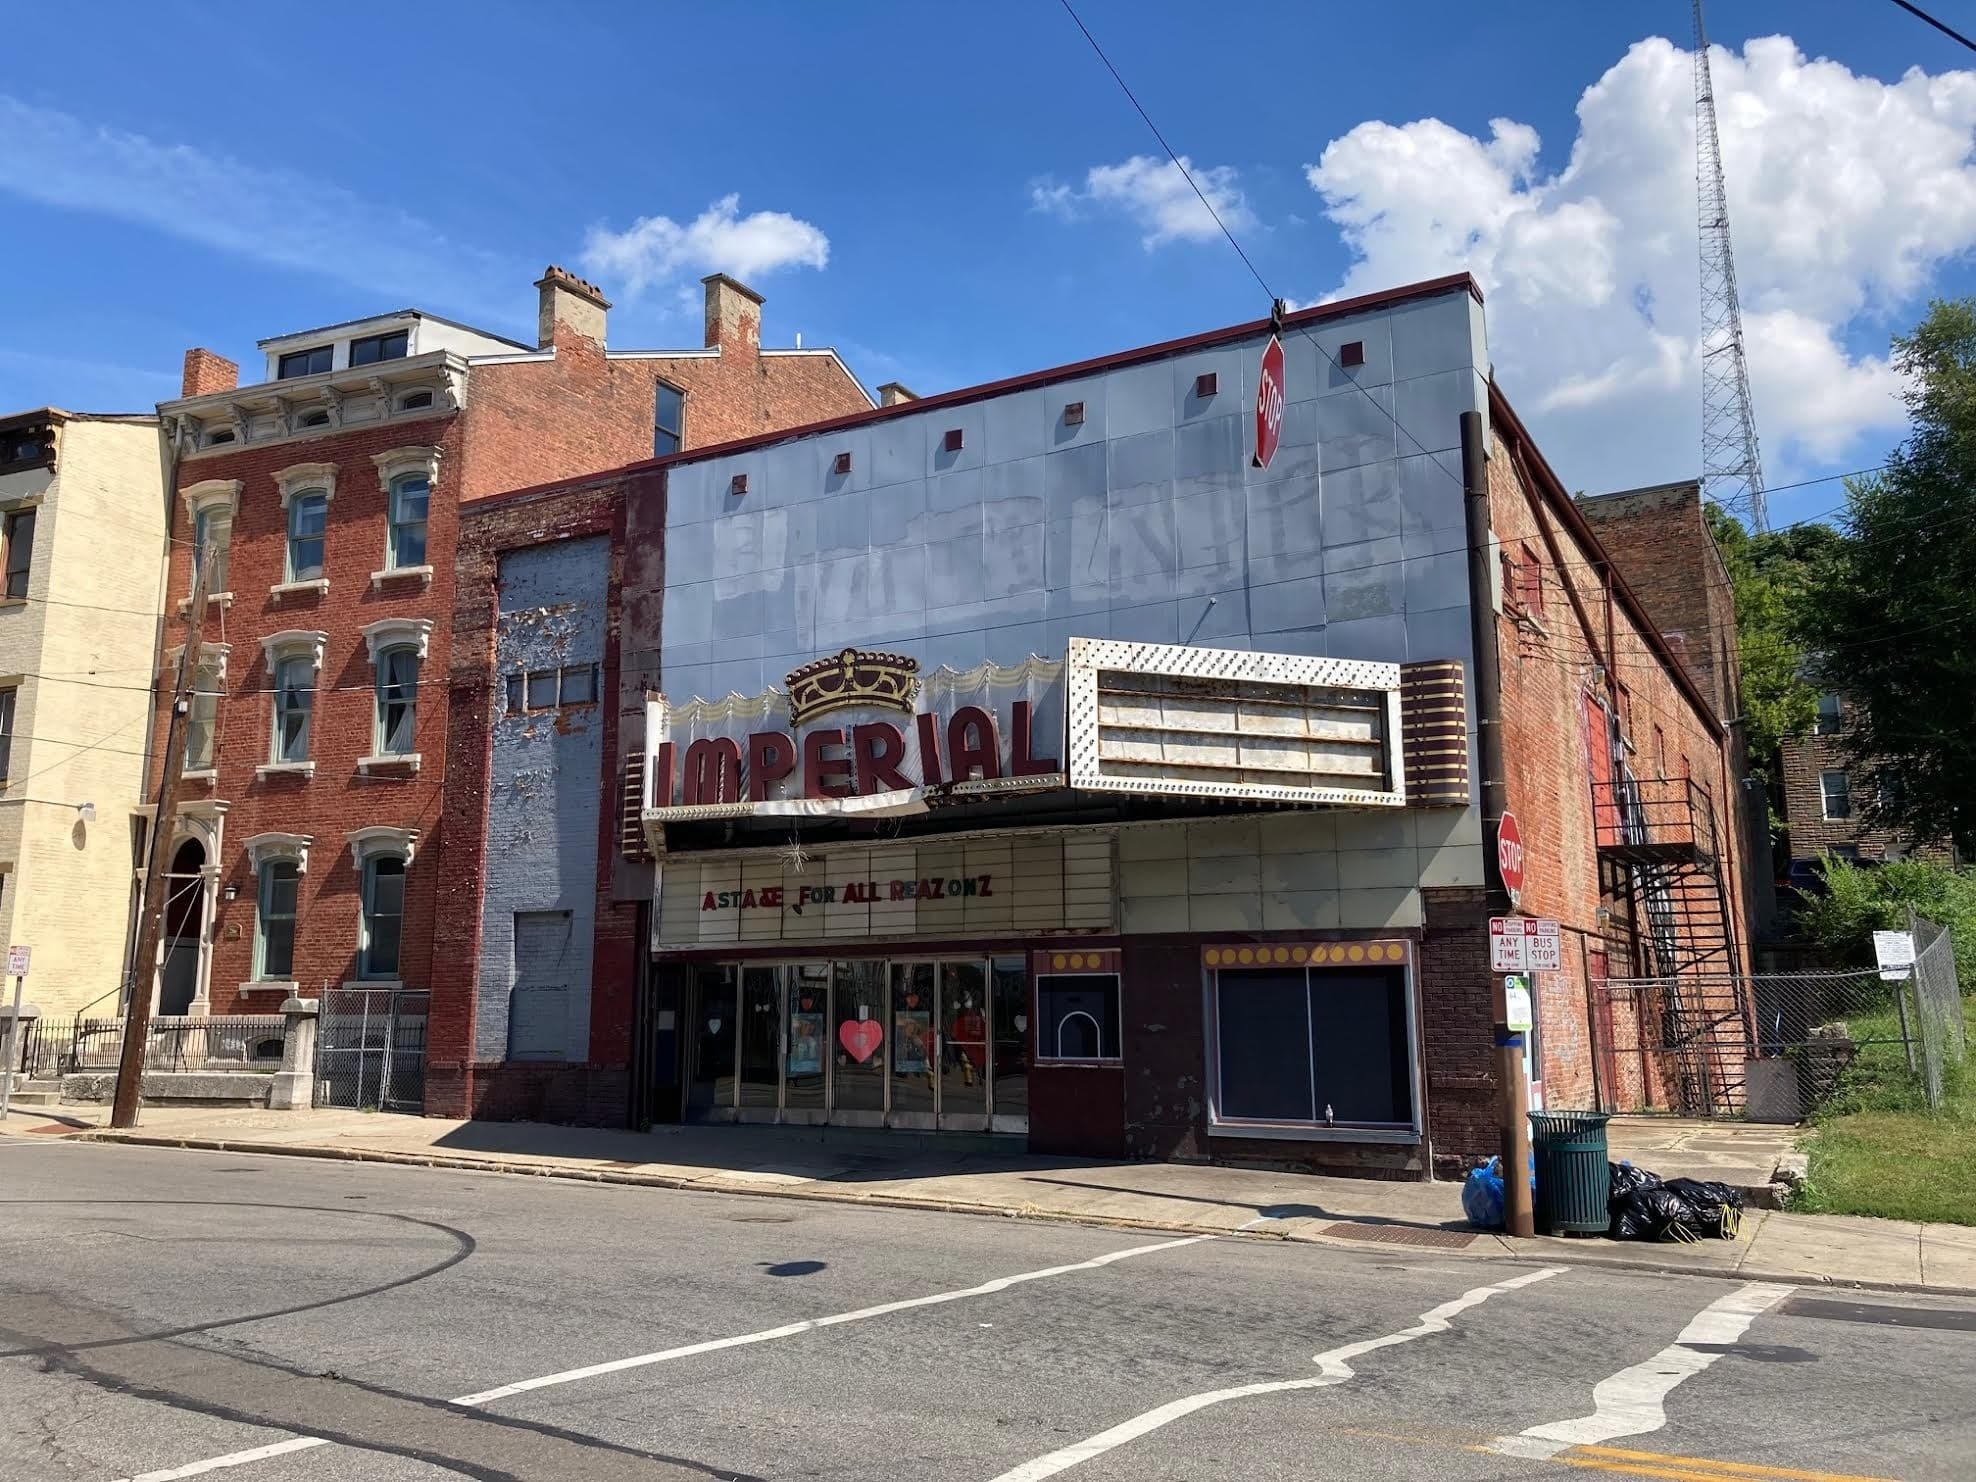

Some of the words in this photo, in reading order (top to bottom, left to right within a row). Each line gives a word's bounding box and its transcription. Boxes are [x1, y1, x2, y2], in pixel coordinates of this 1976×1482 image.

[1258, 368, 1282, 435] STOP
[656, 700, 1057, 808] IMPERIAL
[1501, 837, 1521, 873] STOP
[800, 886, 835, 906] FOR
[842, 882, 882, 904] ALL
[1492, 921, 1503, 932] NO
[1525, 922, 1537, 934] NO
[1500, 937, 1519, 947] ANY
[1533, 937, 1553, 949] BUS
[1498, 949, 1521, 960] TIME
[1531, 950, 1556, 961] STOP
